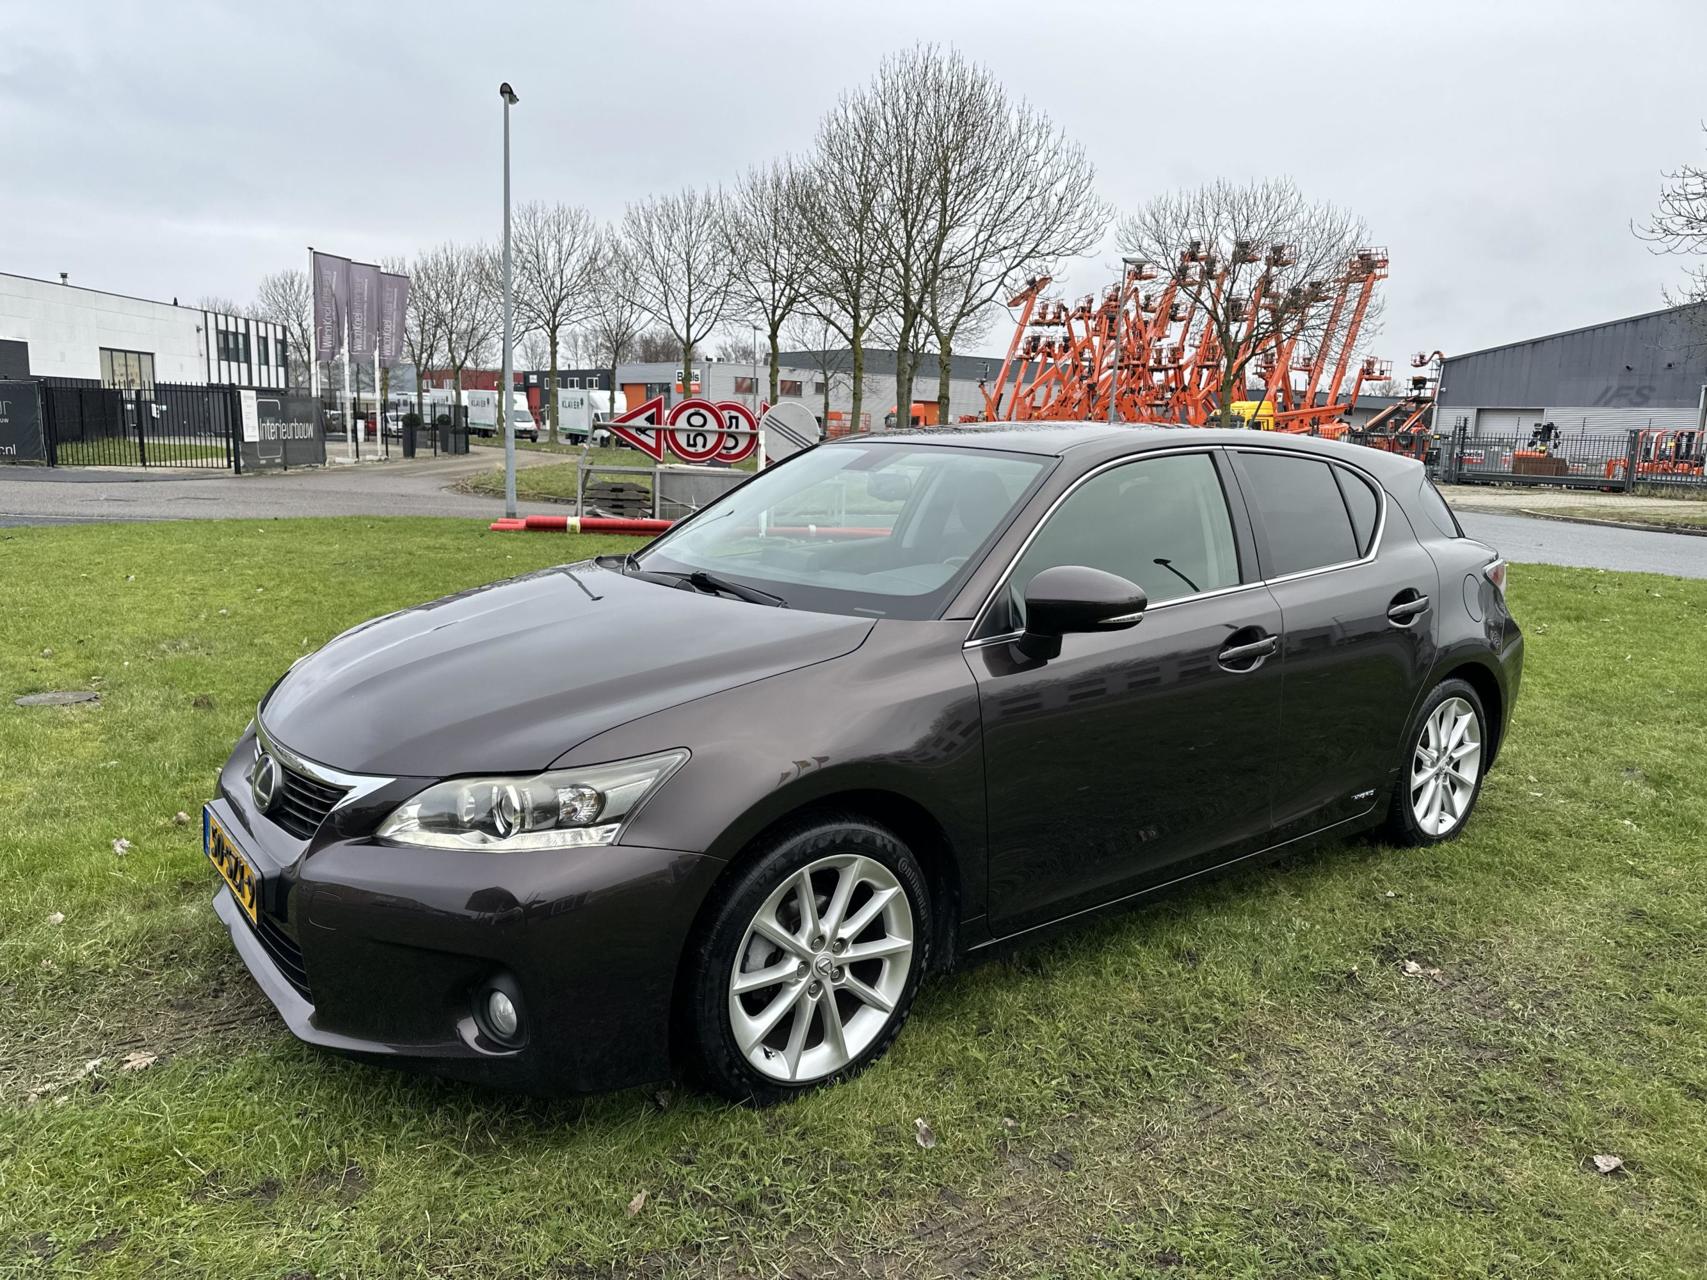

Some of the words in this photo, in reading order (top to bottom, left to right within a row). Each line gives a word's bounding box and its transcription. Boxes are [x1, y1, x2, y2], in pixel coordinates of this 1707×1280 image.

[677, 371, 700, 382] Bls
[259, 417, 314, 441] Interieurbouw
[686, 411, 707, 449] 50
